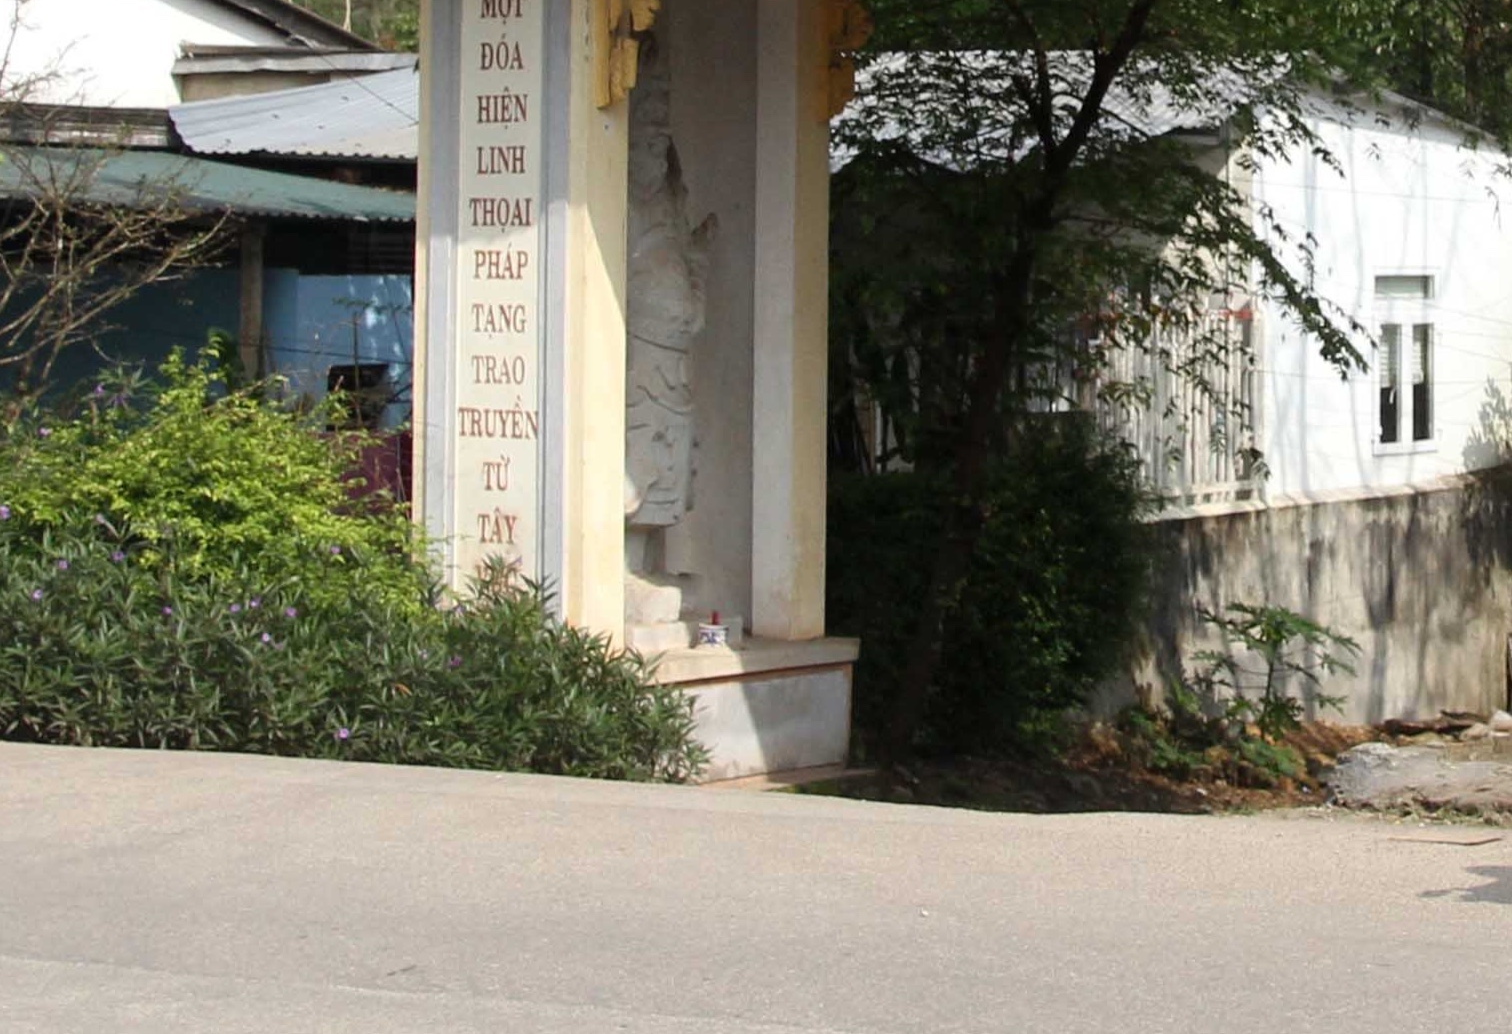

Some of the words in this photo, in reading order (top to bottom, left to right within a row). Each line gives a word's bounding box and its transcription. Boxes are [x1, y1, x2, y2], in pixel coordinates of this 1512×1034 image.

[480, 33, 524, 71] ĐÓA
[477, 87, 528, 130] HIỆN
[477, 146, 526, 175] LINH
[474, 242, 529, 280] PHÁP
[471, 304, 527, 340] TẠNG
[471, 355, 525, 385] TRAO
[458, 396, 540, 440] TRUYỀN
[482, 455, 511, 492] TỪ
[477, 508, 518, 545] TÂY
